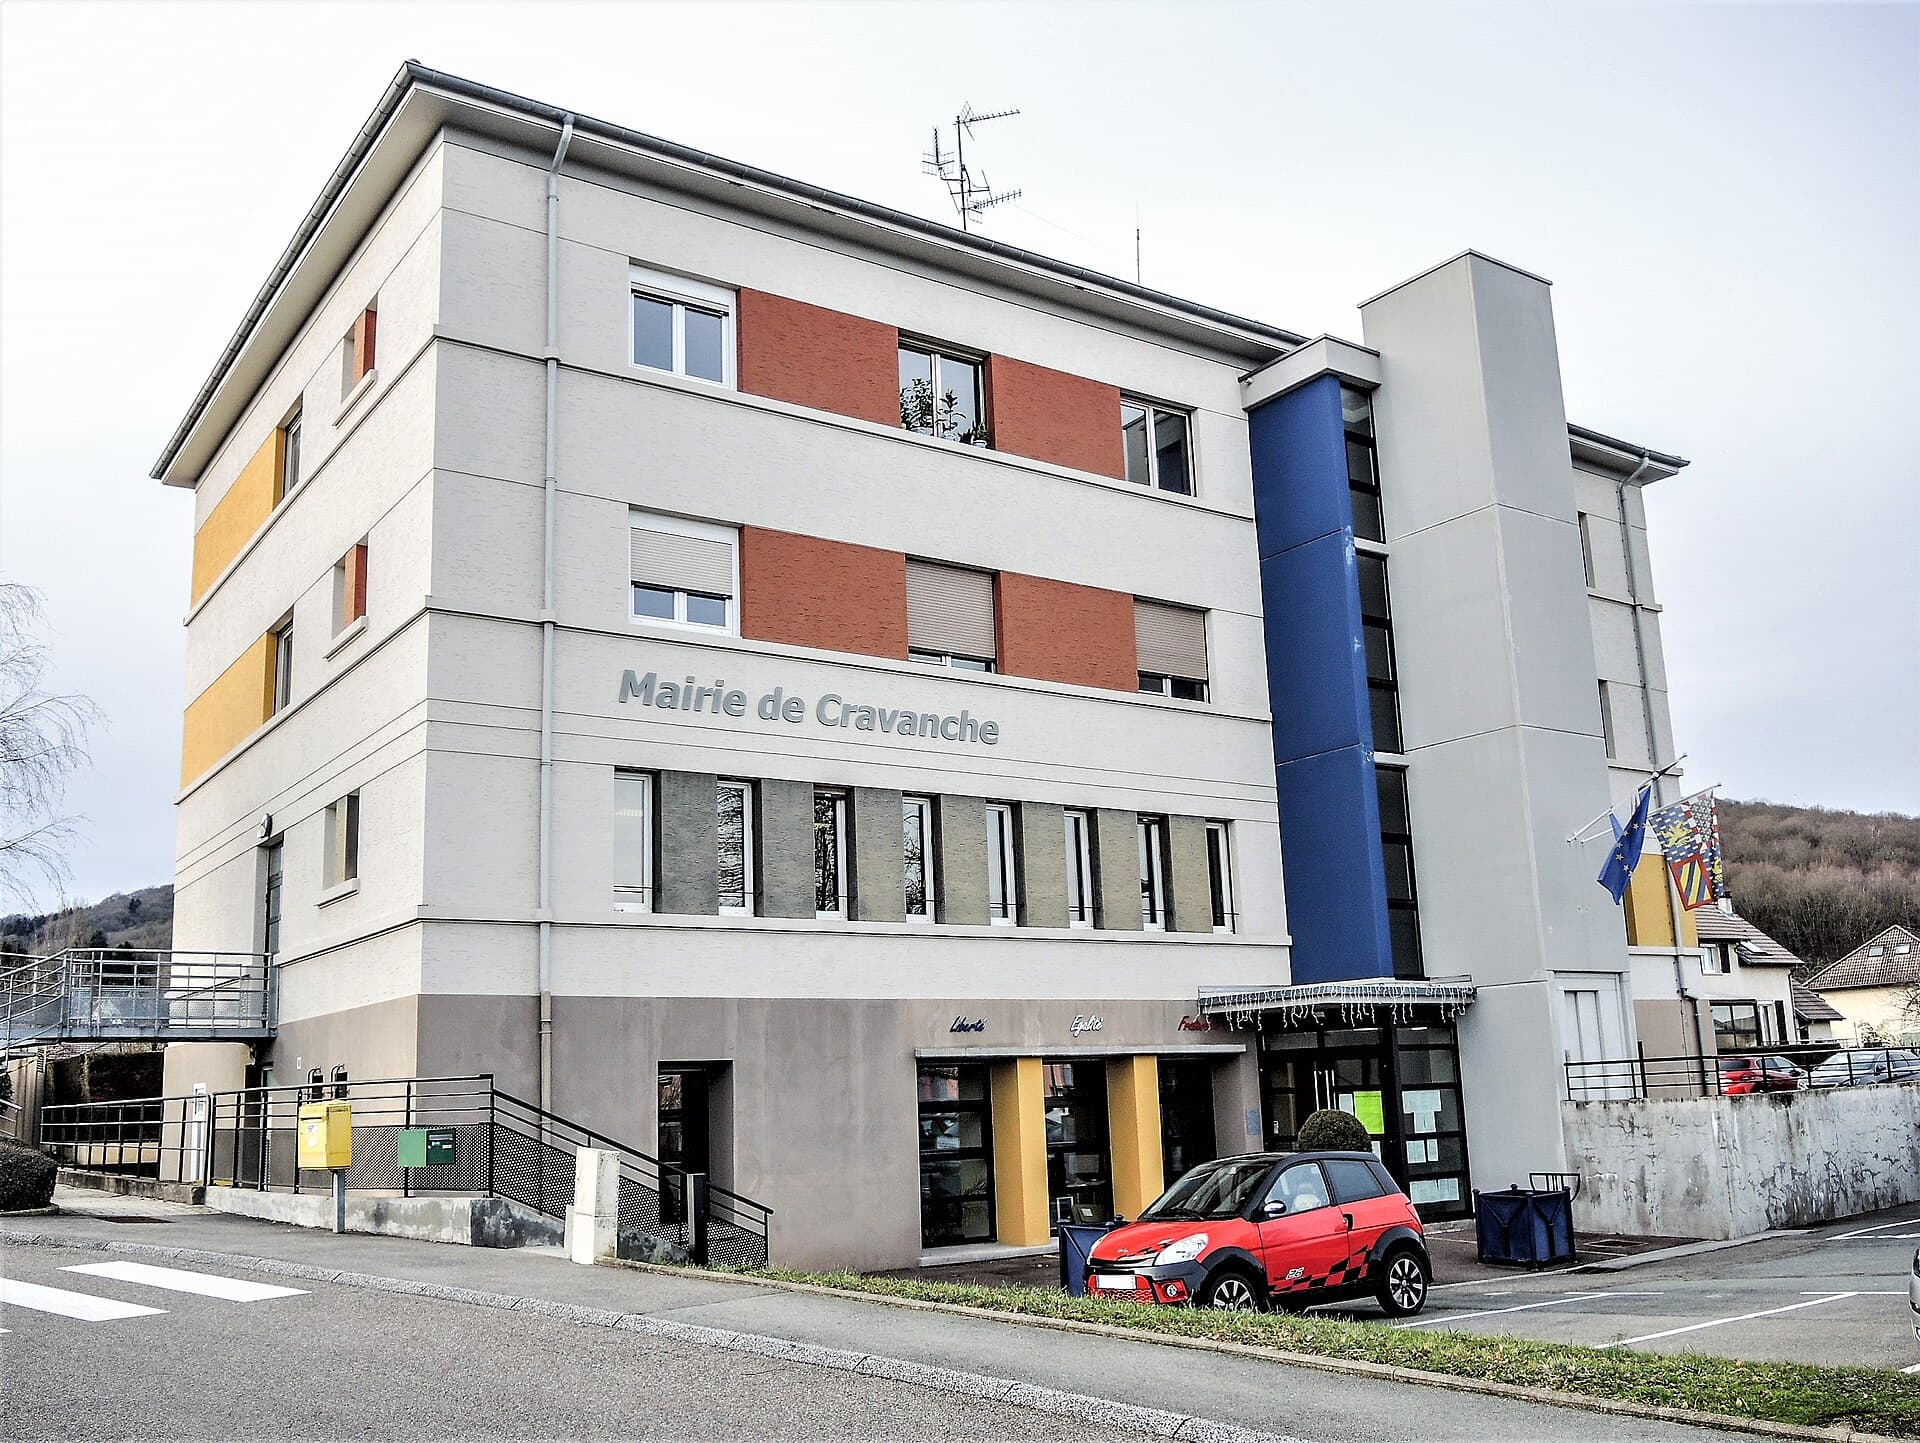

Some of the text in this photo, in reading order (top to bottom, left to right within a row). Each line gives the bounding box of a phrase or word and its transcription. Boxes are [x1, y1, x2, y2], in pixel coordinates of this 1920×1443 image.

[618, 669, 999, 745] Mairie de Cravanche
